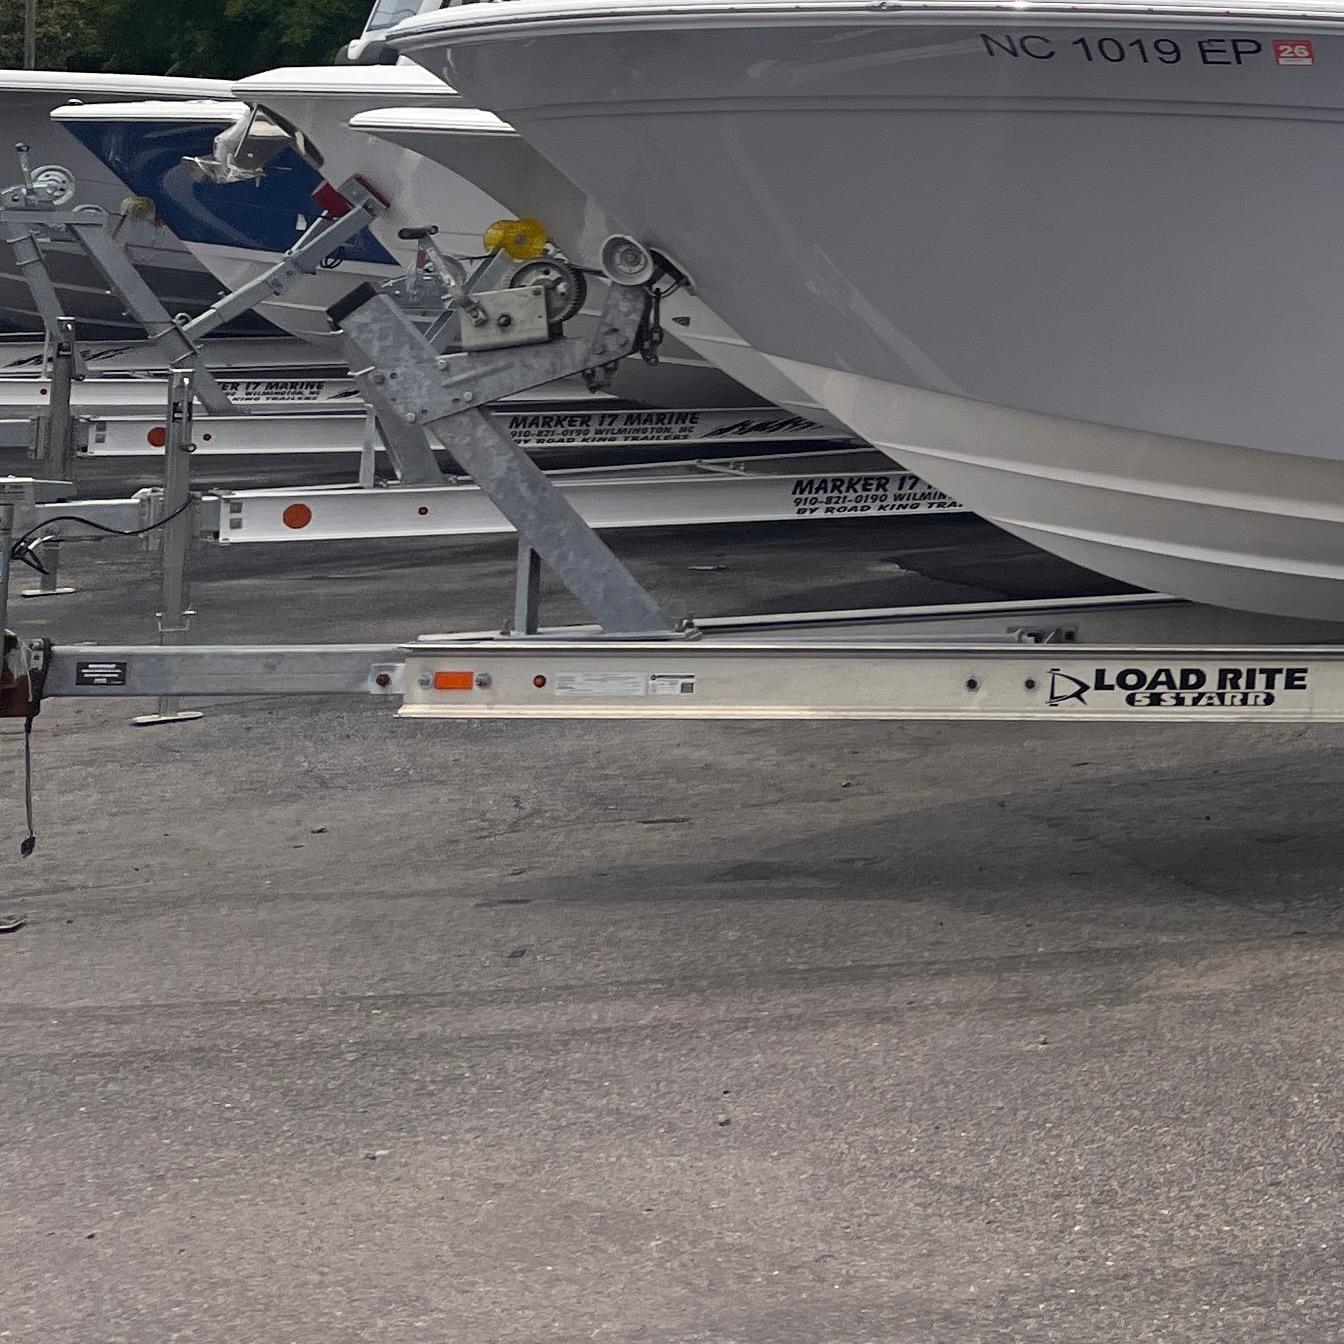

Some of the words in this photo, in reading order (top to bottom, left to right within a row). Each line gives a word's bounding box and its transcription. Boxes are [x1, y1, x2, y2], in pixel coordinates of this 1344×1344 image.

[979, 33, 1056, 60] NC
[1072, 37, 1181, 64] 1019
[1197, 38, 1262, 65] EP
[1279, 45, 1309, 58] 26
[265, 381, 325, 391] MARINE
[509, 414, 592, 429] MARKER
[599, 414, 619, 427] 17
[624, 412, 700, 426] MARINE
[792, 476, 889, 495] MARKER
[898, 475, 920, 491] 17
[793, 494, 888, 506] 910-821-0190
[893, 491, 952, 502] WILMIN
[824, 505, 871, 514] ROAD
[878, 502, 920, 511] KING
[927, 501, 963, 509] TRA
[1093, 668, 1207, 691] LOAD
[1217, 668, 1308, 690] RITE
[1133, 693, 1150, 706] 5
[1160, 693, 1269, 706] STARR
